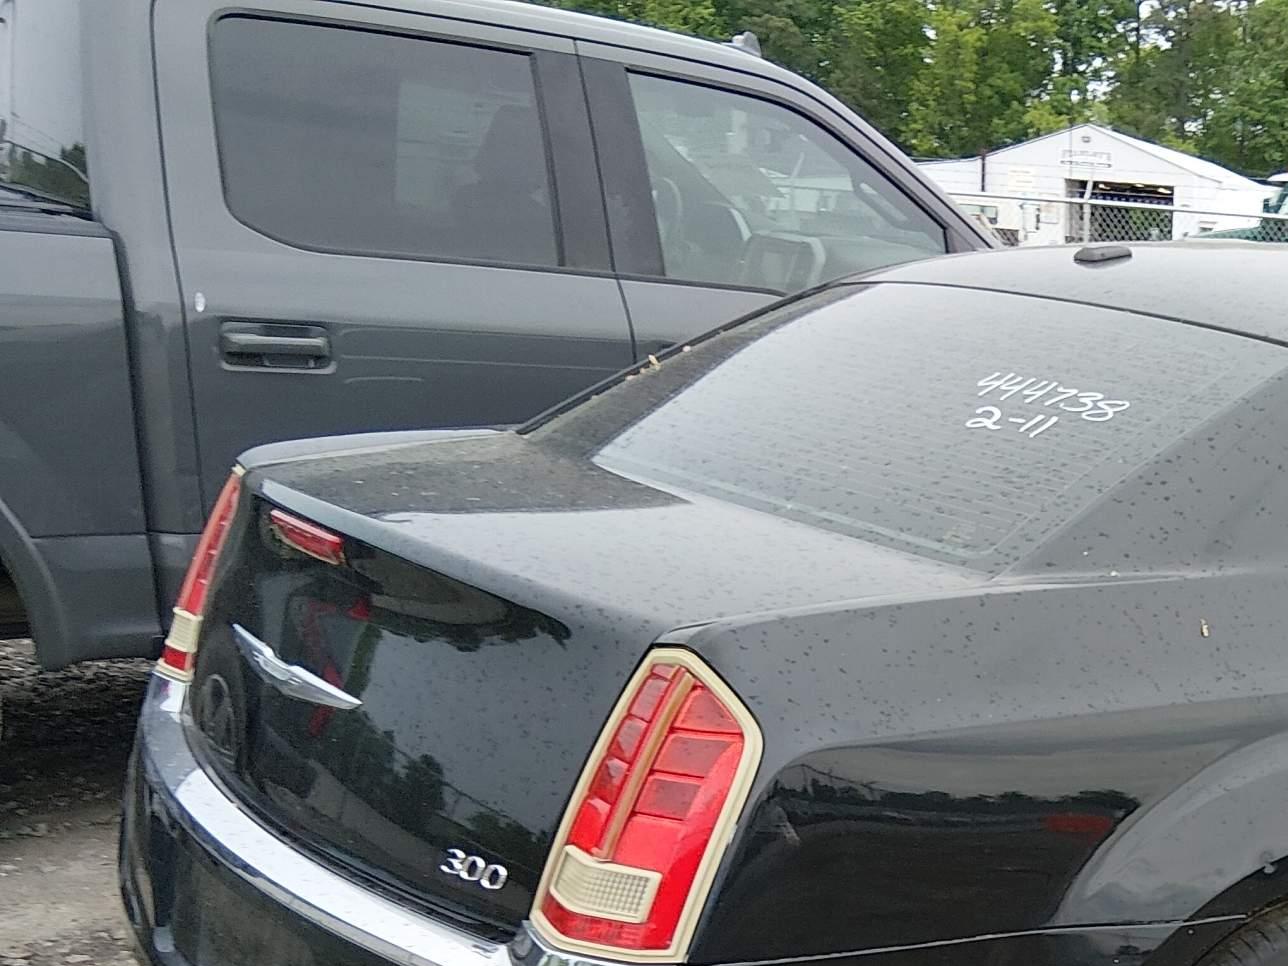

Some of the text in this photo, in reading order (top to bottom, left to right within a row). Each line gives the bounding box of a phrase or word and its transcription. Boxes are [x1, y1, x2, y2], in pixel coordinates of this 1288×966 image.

[977, 372, 1131, 421] 444738
[965, 406, 1059, 438] 2-11
[439, 848, 509, 890] 300
